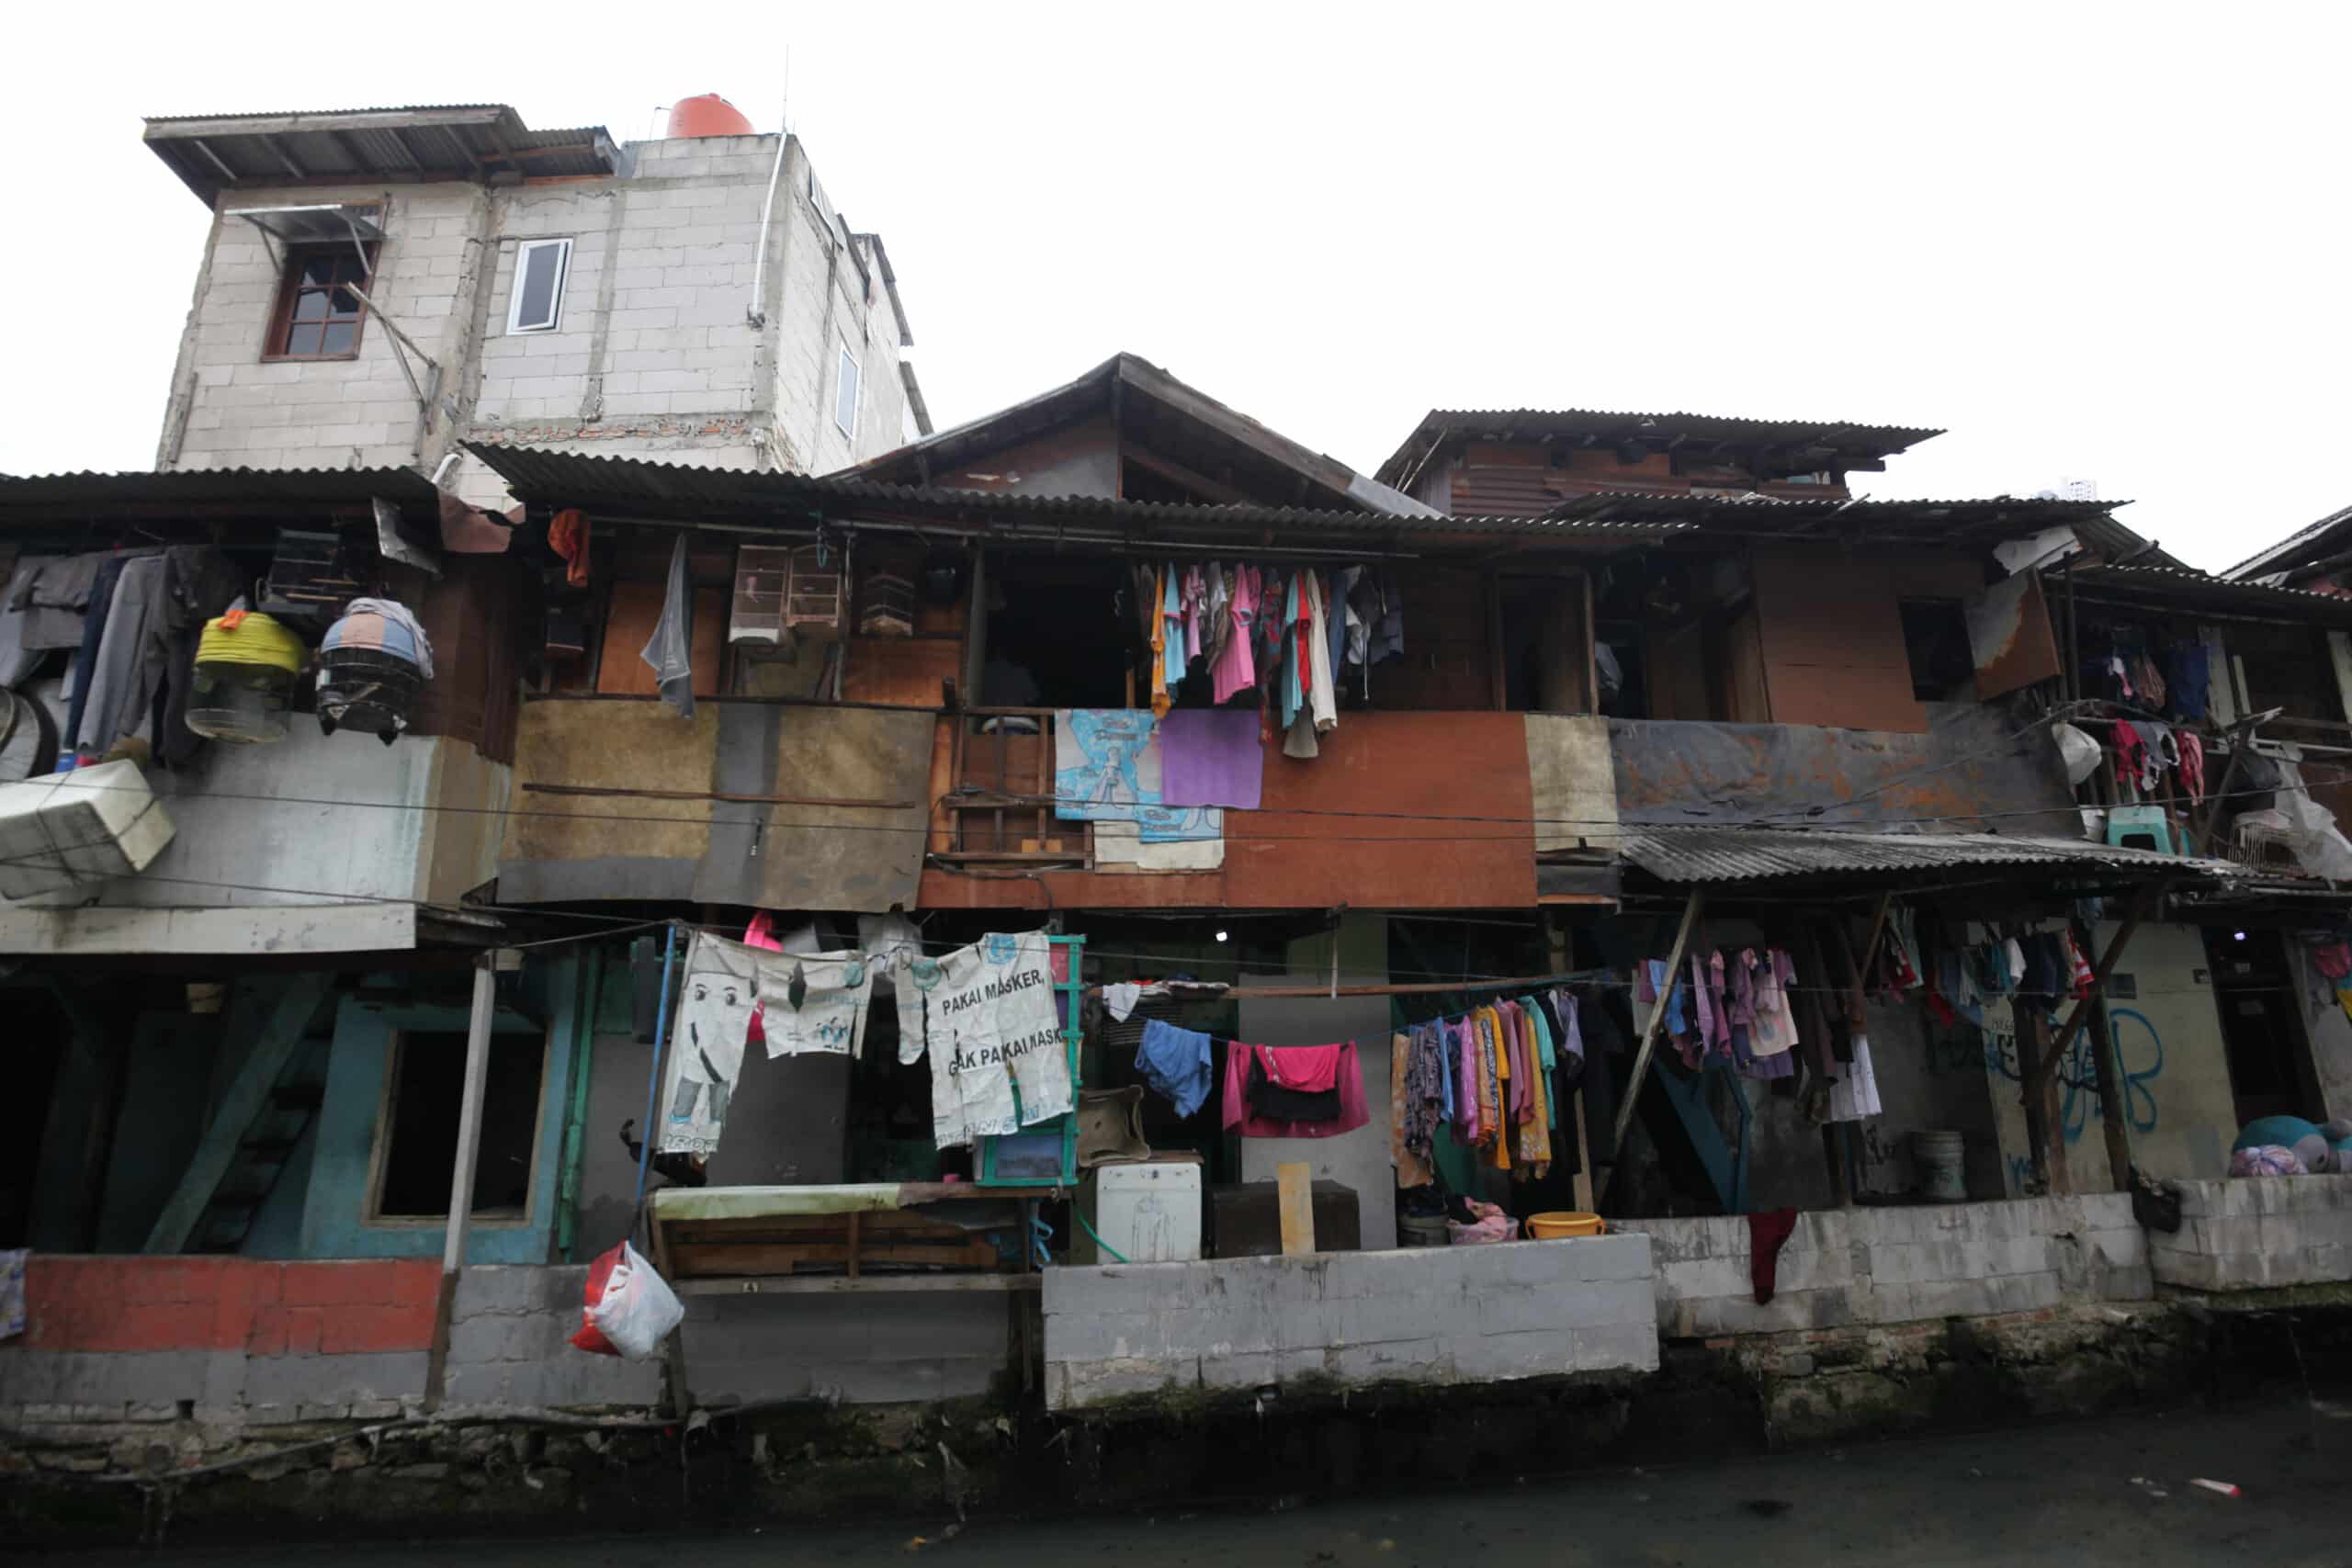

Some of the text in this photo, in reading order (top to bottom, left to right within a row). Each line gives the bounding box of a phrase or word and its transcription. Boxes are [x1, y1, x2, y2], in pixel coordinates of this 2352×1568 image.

[943, 969, 1046, 1016] PAKAI MASKER,
[948, 1050, 977, 1077] GAK
[981, 1036, 1028, 1066] PAKAI
